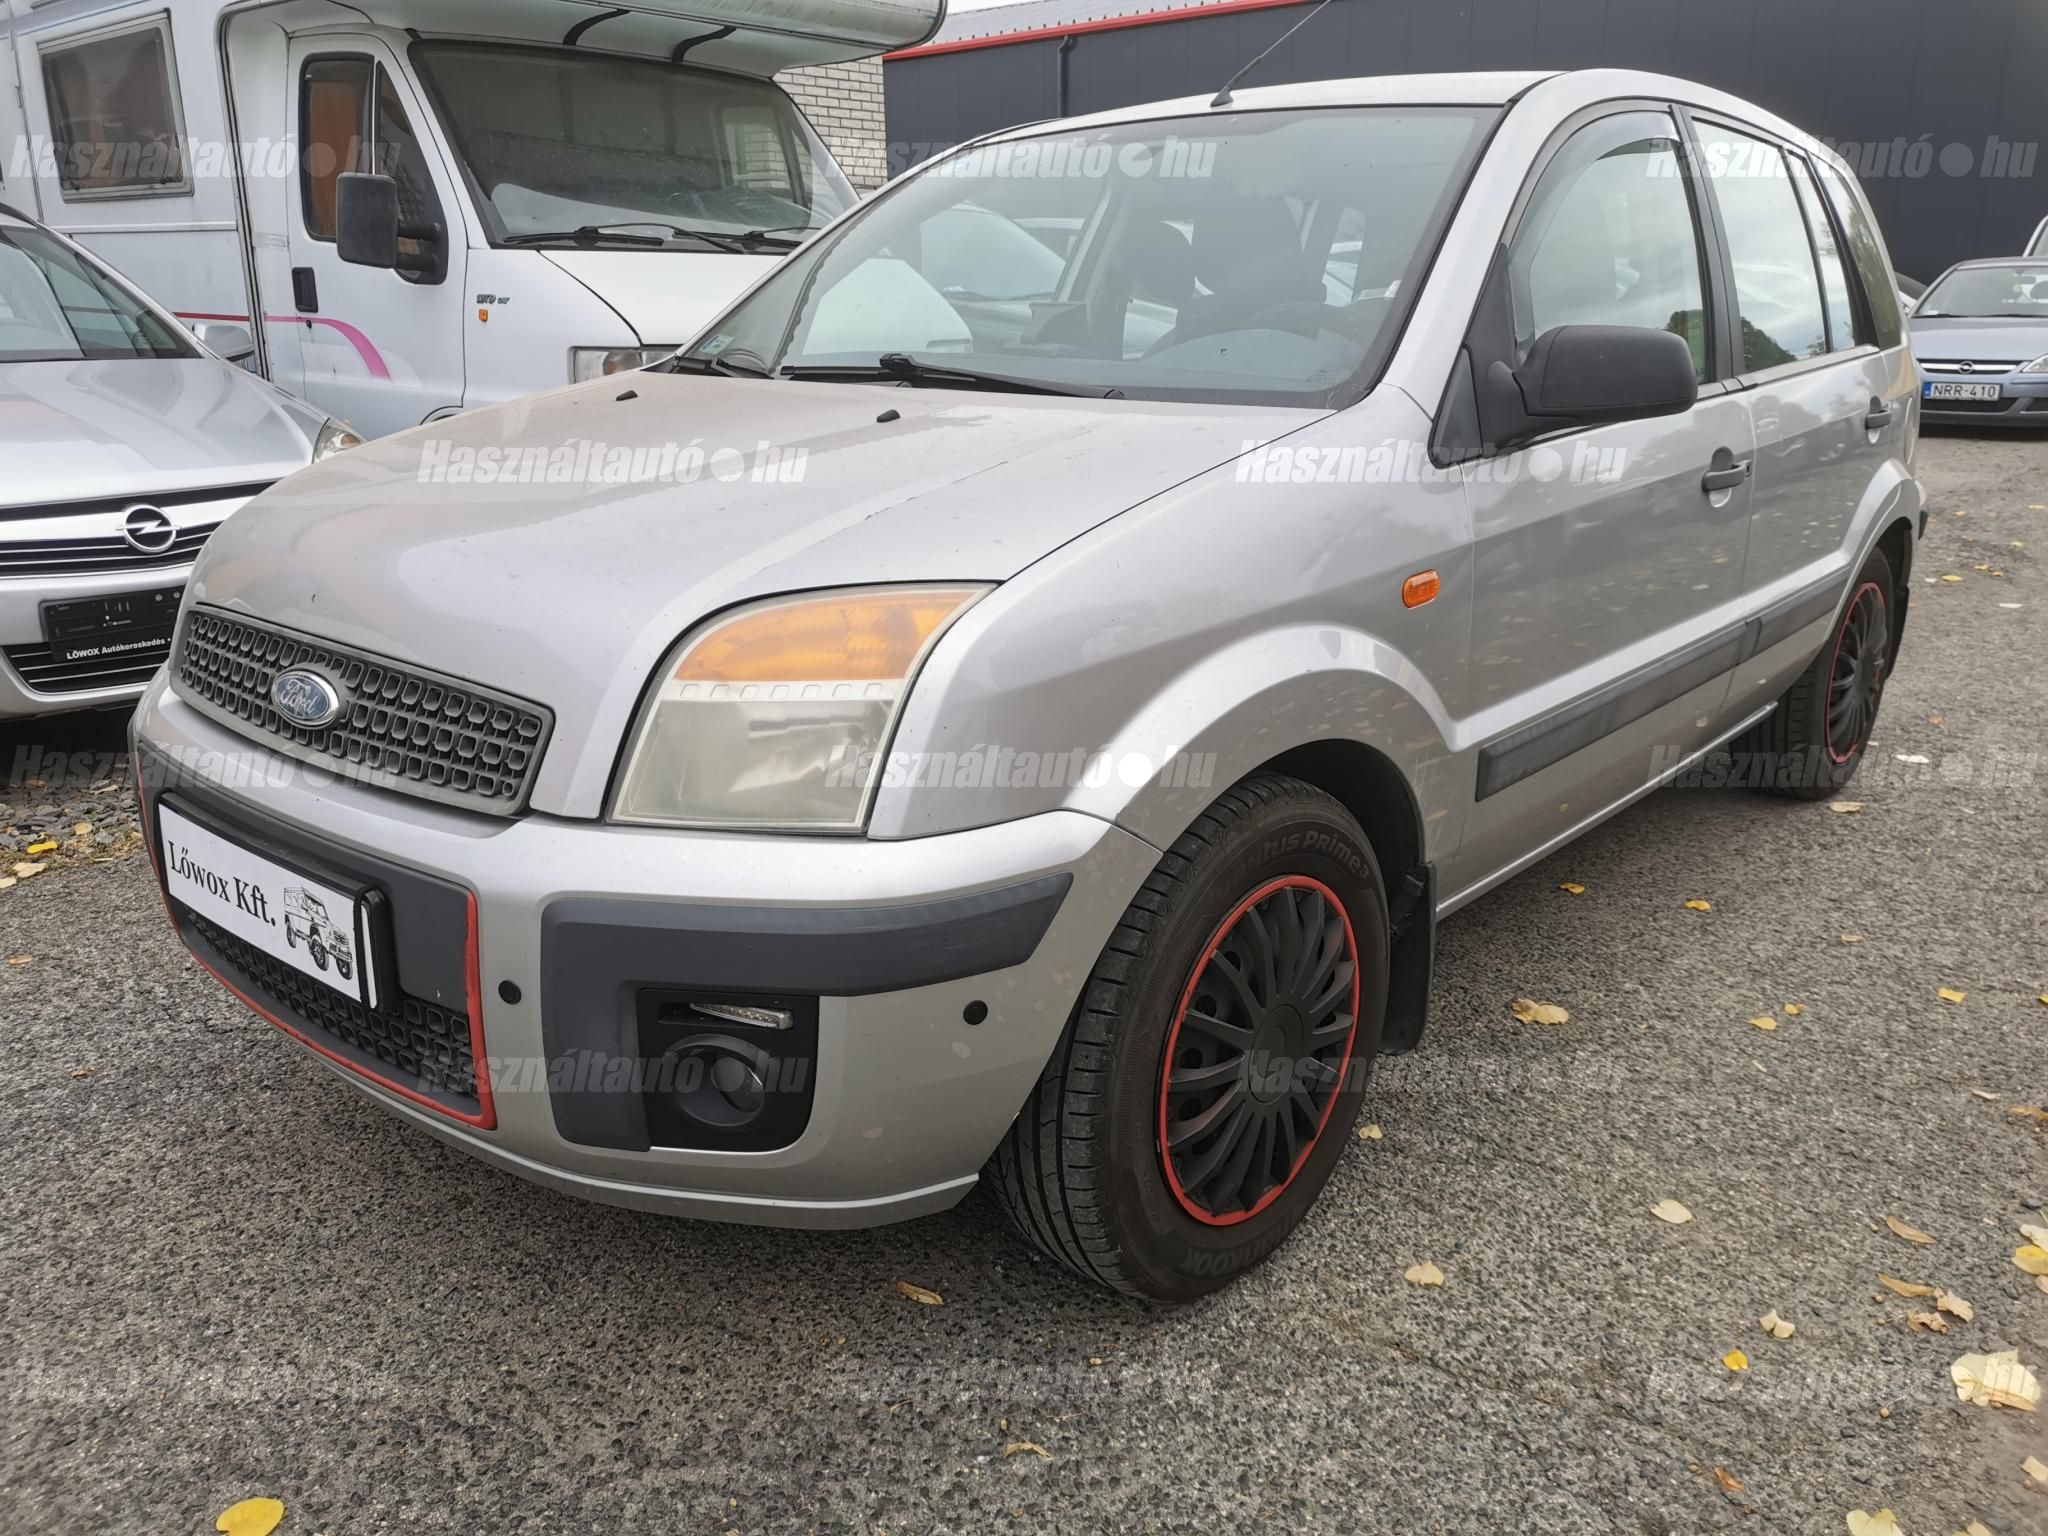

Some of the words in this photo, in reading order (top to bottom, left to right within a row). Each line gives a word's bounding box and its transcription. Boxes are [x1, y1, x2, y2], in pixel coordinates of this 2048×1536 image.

[1933, 384, 1996, 398] NRR-410
[101, 638, 166, 655] Autókereskedés
[167, 840, 231, 904] Lőwox
[233, 876, 276, 927] Kft.
